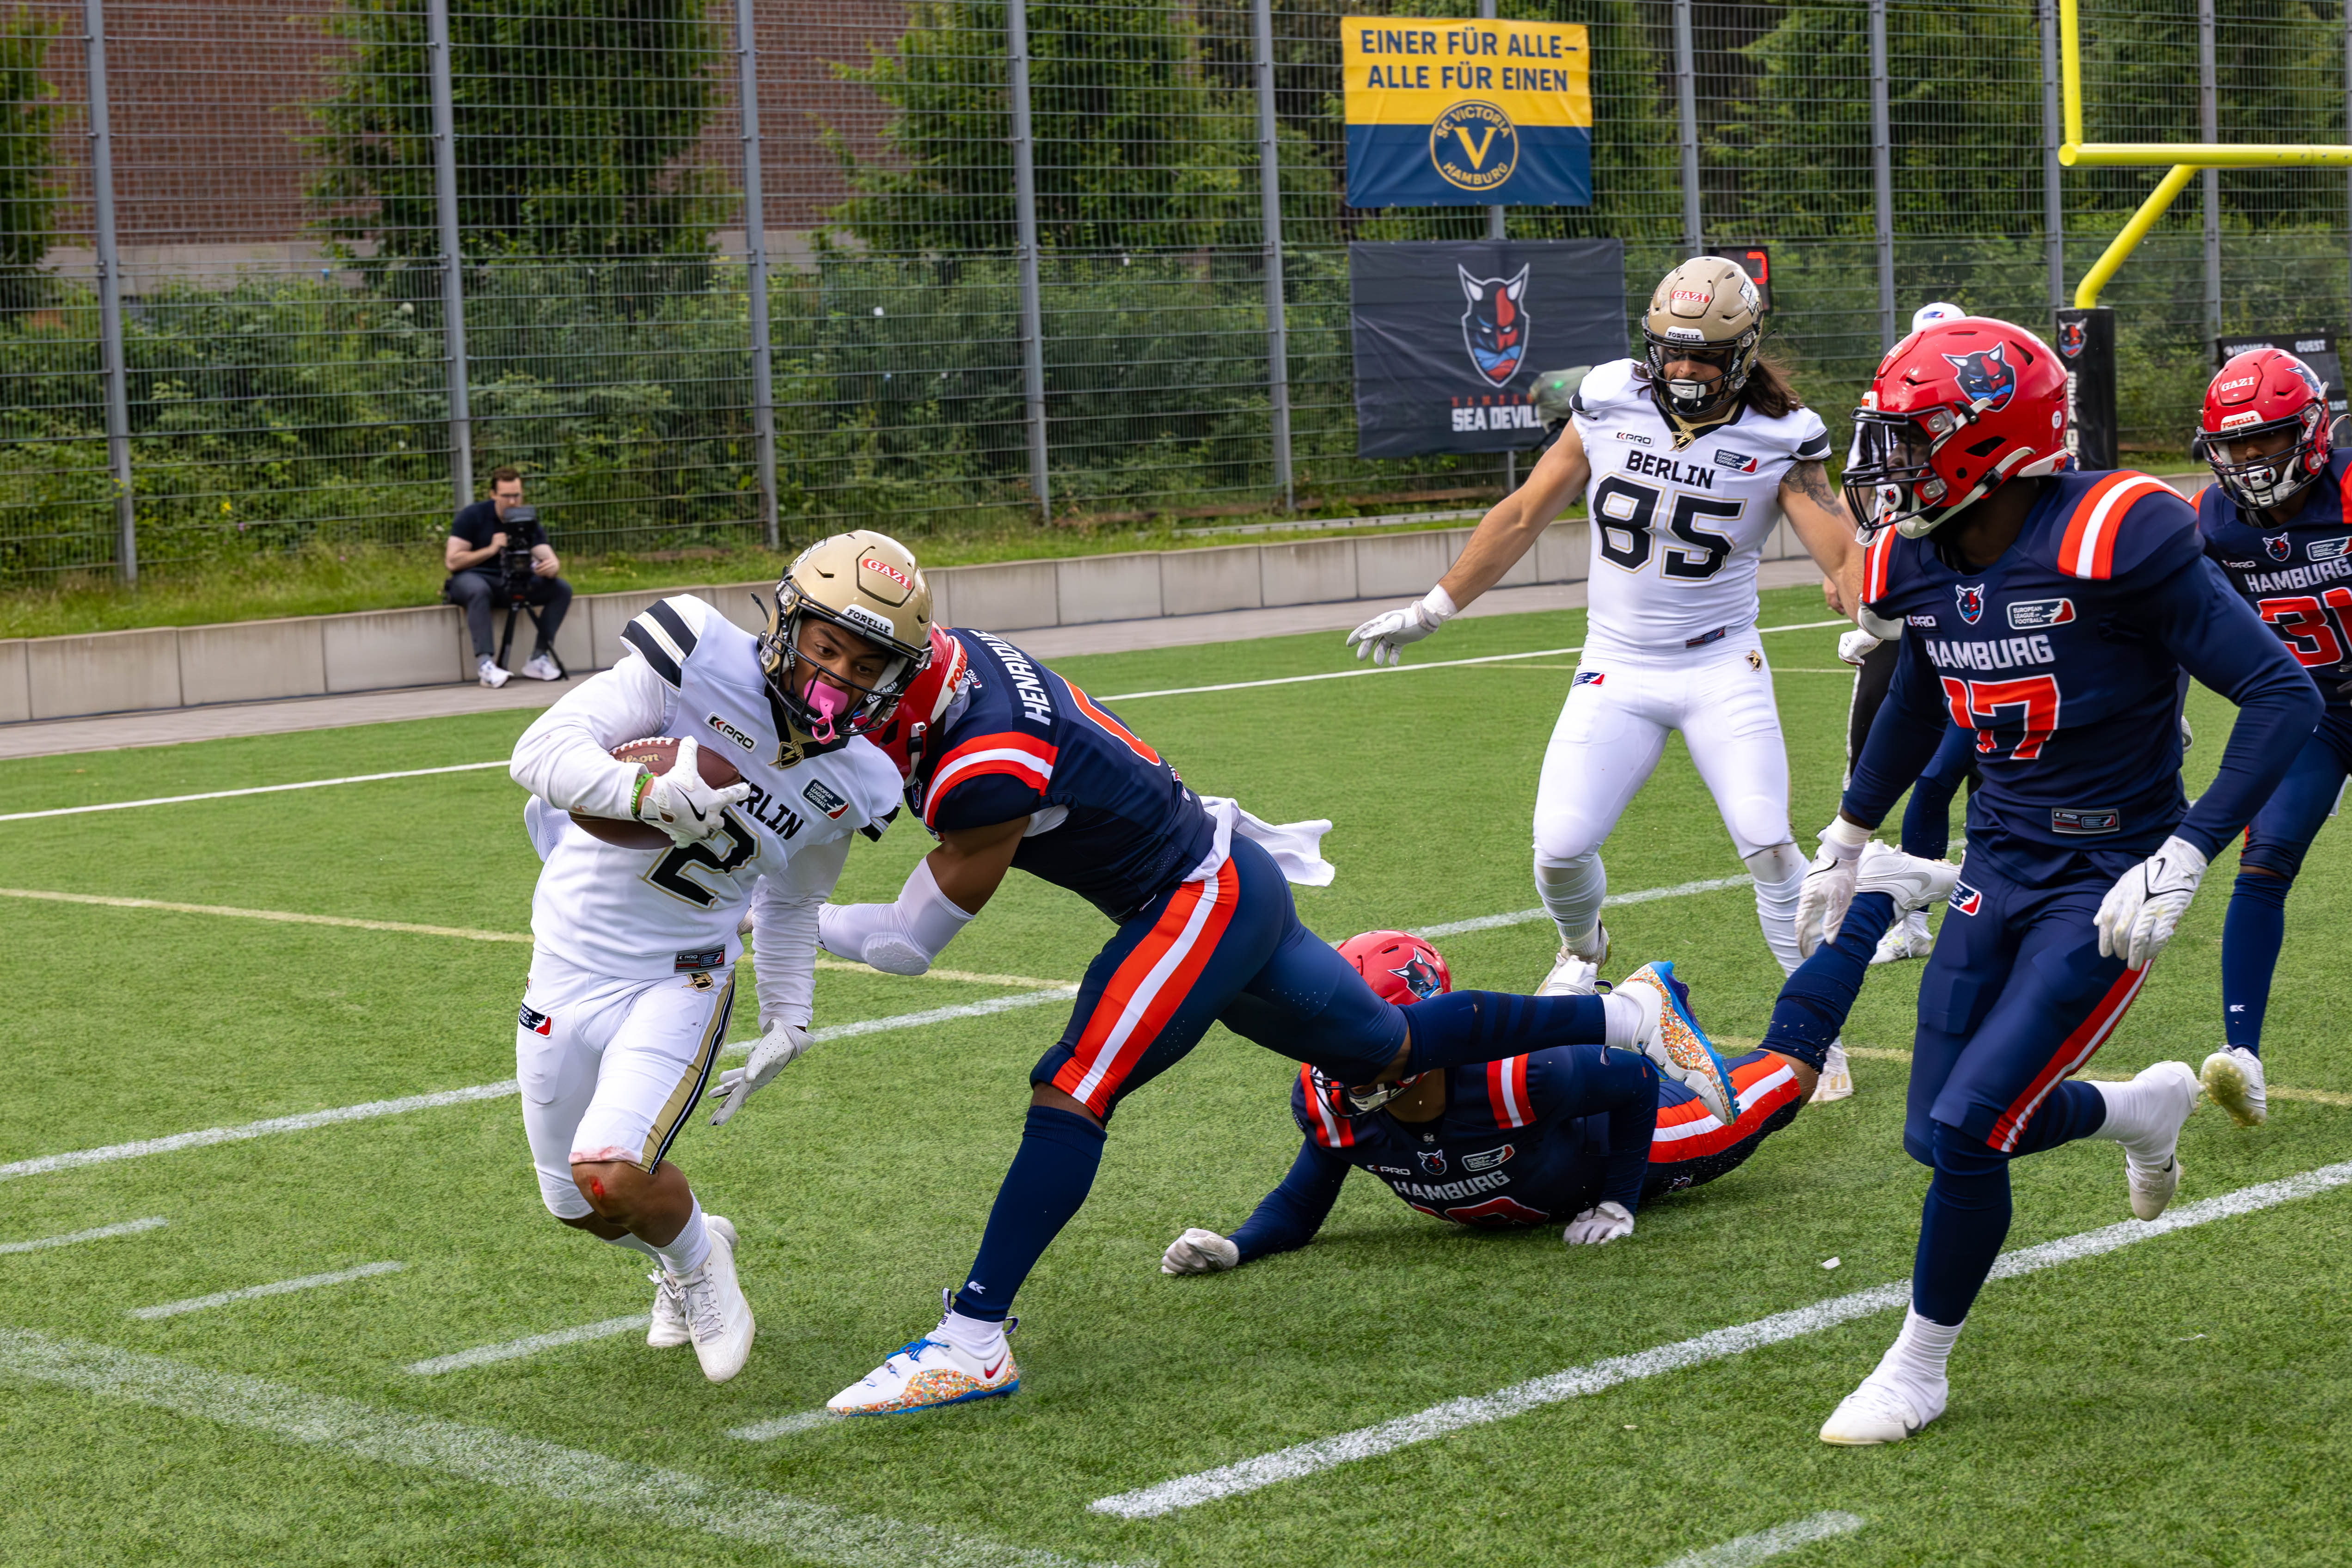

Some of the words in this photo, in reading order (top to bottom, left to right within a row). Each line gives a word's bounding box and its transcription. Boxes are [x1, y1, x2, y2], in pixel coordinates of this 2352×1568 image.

[1361, 30, 1436, 54] EINER
[1448, 27, 1497, 55] FÜR
[1367, 65, 1429, 88] ALLE
[1442, 61, 1493, 89] FÜR
[1502, 67, 1568, 92] EINEN
[1436, 119, 1454, 139] SC
[1450, 106, 1510, 138] VICTORIA
[1453, 127, 1497, 170] V
[1443, 162, 1508, 185] HAMBURG
[1668, 331, 1700, 340] FORELLE
[1452, 407, 1488, 431] SEA
[1626, 450, 1715, 489] BERLIN
[1592, 472, 1747, 582] 85
[2244, 557, 2352, 593] HAMBURG
[847, 609, 891, 634] FORELLE
[1926, 635, 2055, 670] HAMBURG
[968, 630, 1051, 726] HENRIQUE
[1940, 674, 2061, 760] 17
[736, 775, 805, 840] RLIN
[807, 791, 827, 808] FOOTBALL
[810, 787, 826, 800] LEAGUE
[813, 783, 834, 800] EUROPEAN
[643, 804, 760, 909] 2
[1393, 1170, 1510, 1200] HAMBURG
